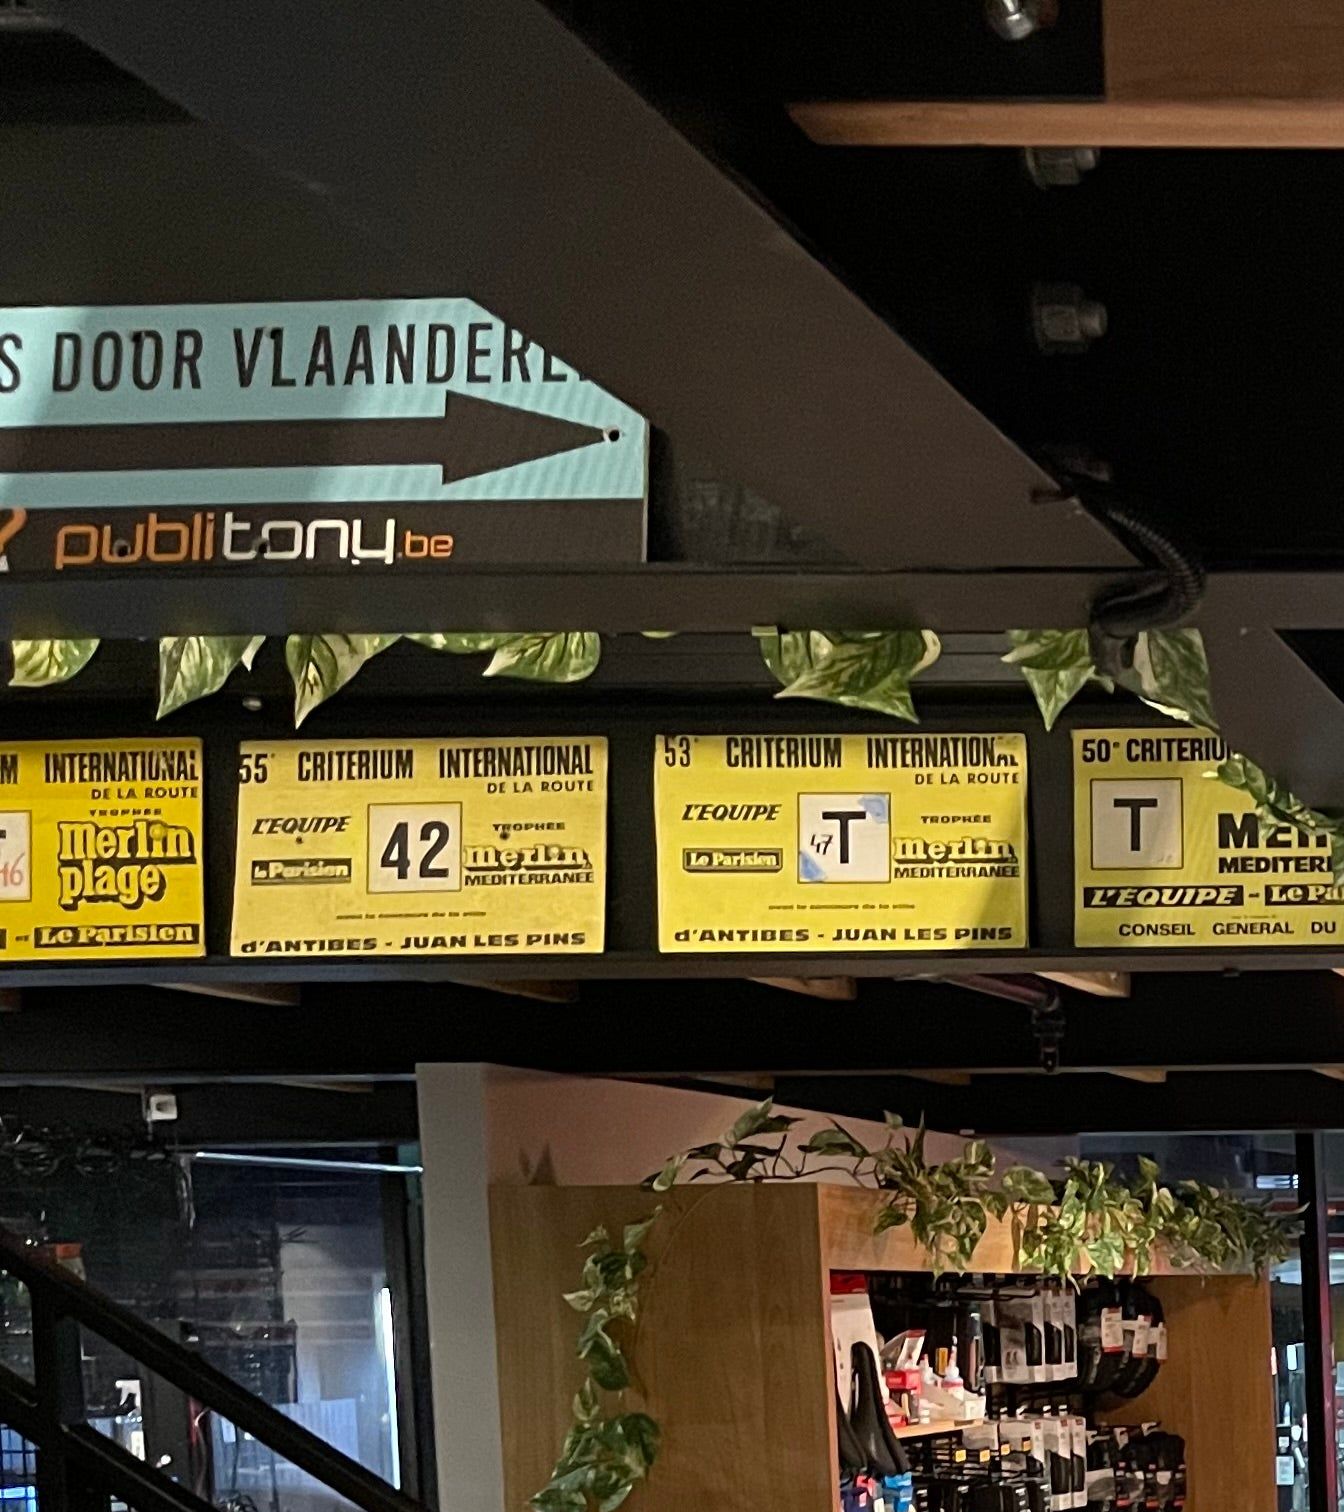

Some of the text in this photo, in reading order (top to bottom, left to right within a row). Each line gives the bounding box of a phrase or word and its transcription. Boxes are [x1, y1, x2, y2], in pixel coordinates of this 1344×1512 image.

[52, 328, 203, 392] DOOR
[726, 737, 842, 768] CRITERIUM
[44, 750, 199, 784] INTERNATIONAL
[297, 748, 414, 782] CRITERIUM
[439, 744, 594, 779] INTERNATIONAL
[486, 779, 594, 794] DE LA ROUTE
[914, 771, 1020, 785] DE LA ROUTE
[90, 786, 199, 800] DE LA ROUTE
[682, 803, 782, 821] L'EQUIPE
[252, 815, 352, 835] L'EQUIPE
[1113, 797, 1159, 852] T
[821, 810, 867, 865] T
[380, 820, 450, 880] 42
[712, 851, 778, 867] Parisien
[1218, 855, 1333, 874] MEDITER
[58, 858, 166, 909] plage
[1269, 885, 1304, 903] Le
[39, 927, 73, 946] Le
[77, 925, 195, 944] Parisien
[674, 928, 810, 942] d'ANTIBES
[832, 928, 896, 942] JUAN
[904, 927, 948, 941] LES
[954, 926, 1012, 941] PINS
[1118, 923, 1196, 937] CONSEIL
[1212, 921, 1295, 936] GENERAL
[1311, 921, 1336, 935] DU
[240, 937, 377, 954] d'ANTIBES
[400, 934, 467, 950] JUAN
[474, 933, 519, 947] LES
[526, 931, 586, 947] PINS
